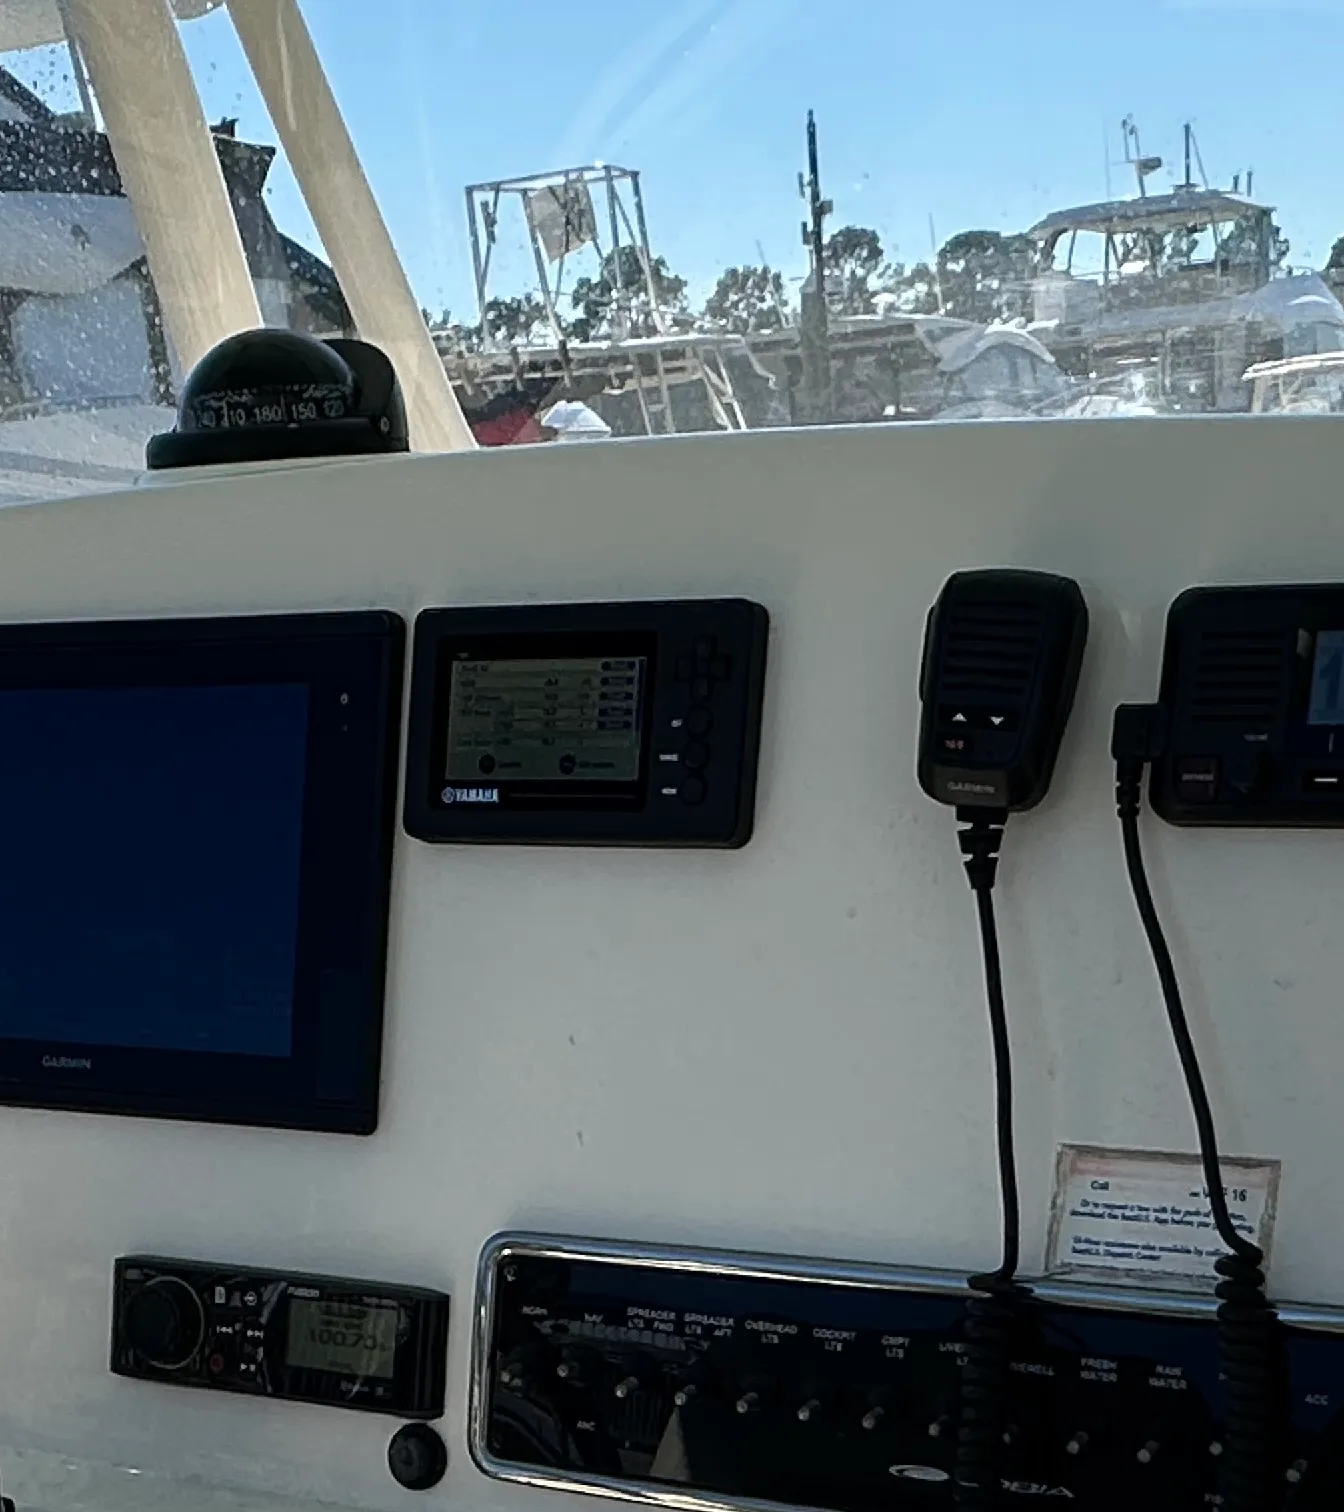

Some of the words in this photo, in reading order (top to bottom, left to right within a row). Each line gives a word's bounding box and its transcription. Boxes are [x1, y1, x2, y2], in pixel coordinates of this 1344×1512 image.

[253, 404, 282, 423] 180
[291, 402, 318, 420] 150
[454, 788, 500, 804] YAMAHA
[1232, 1189, 1247, 1201] 16
[745, 1319, 799, 1335] OVERHEAD
[1304, 1393, 1329, 1406] ACC
